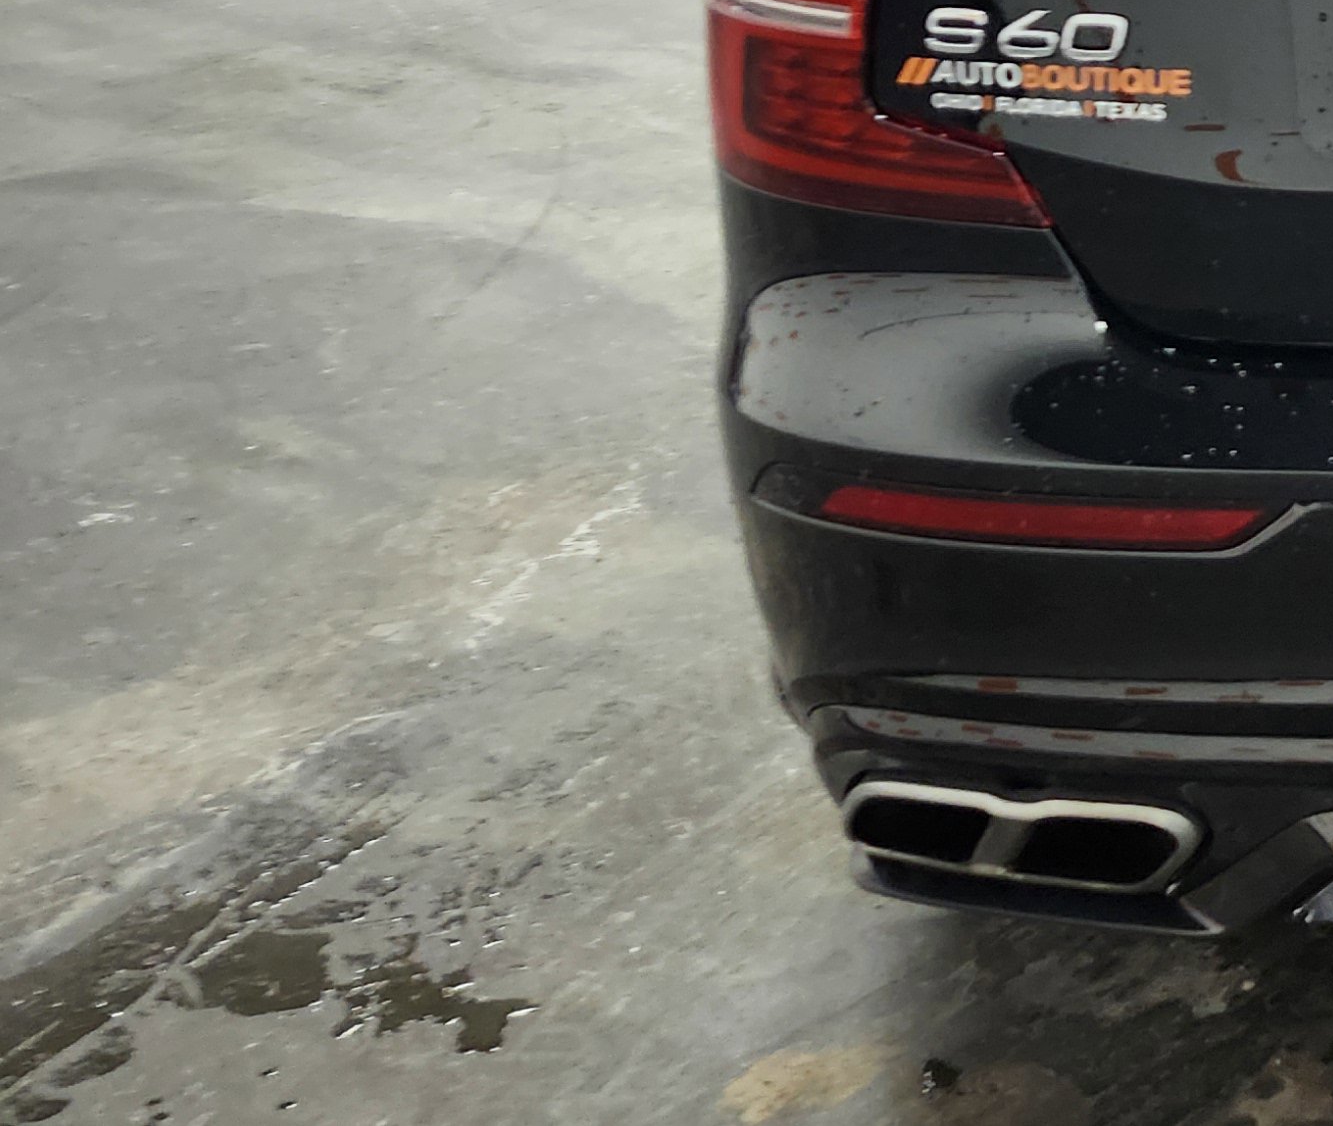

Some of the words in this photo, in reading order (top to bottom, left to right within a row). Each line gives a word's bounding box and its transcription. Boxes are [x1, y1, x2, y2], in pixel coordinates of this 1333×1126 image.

[923, 6, 1130, 62] S60
[929, 59, 1193, 96] AUTOBOUTIQUE
[1094, 100, 1168, 122] TEXAS
